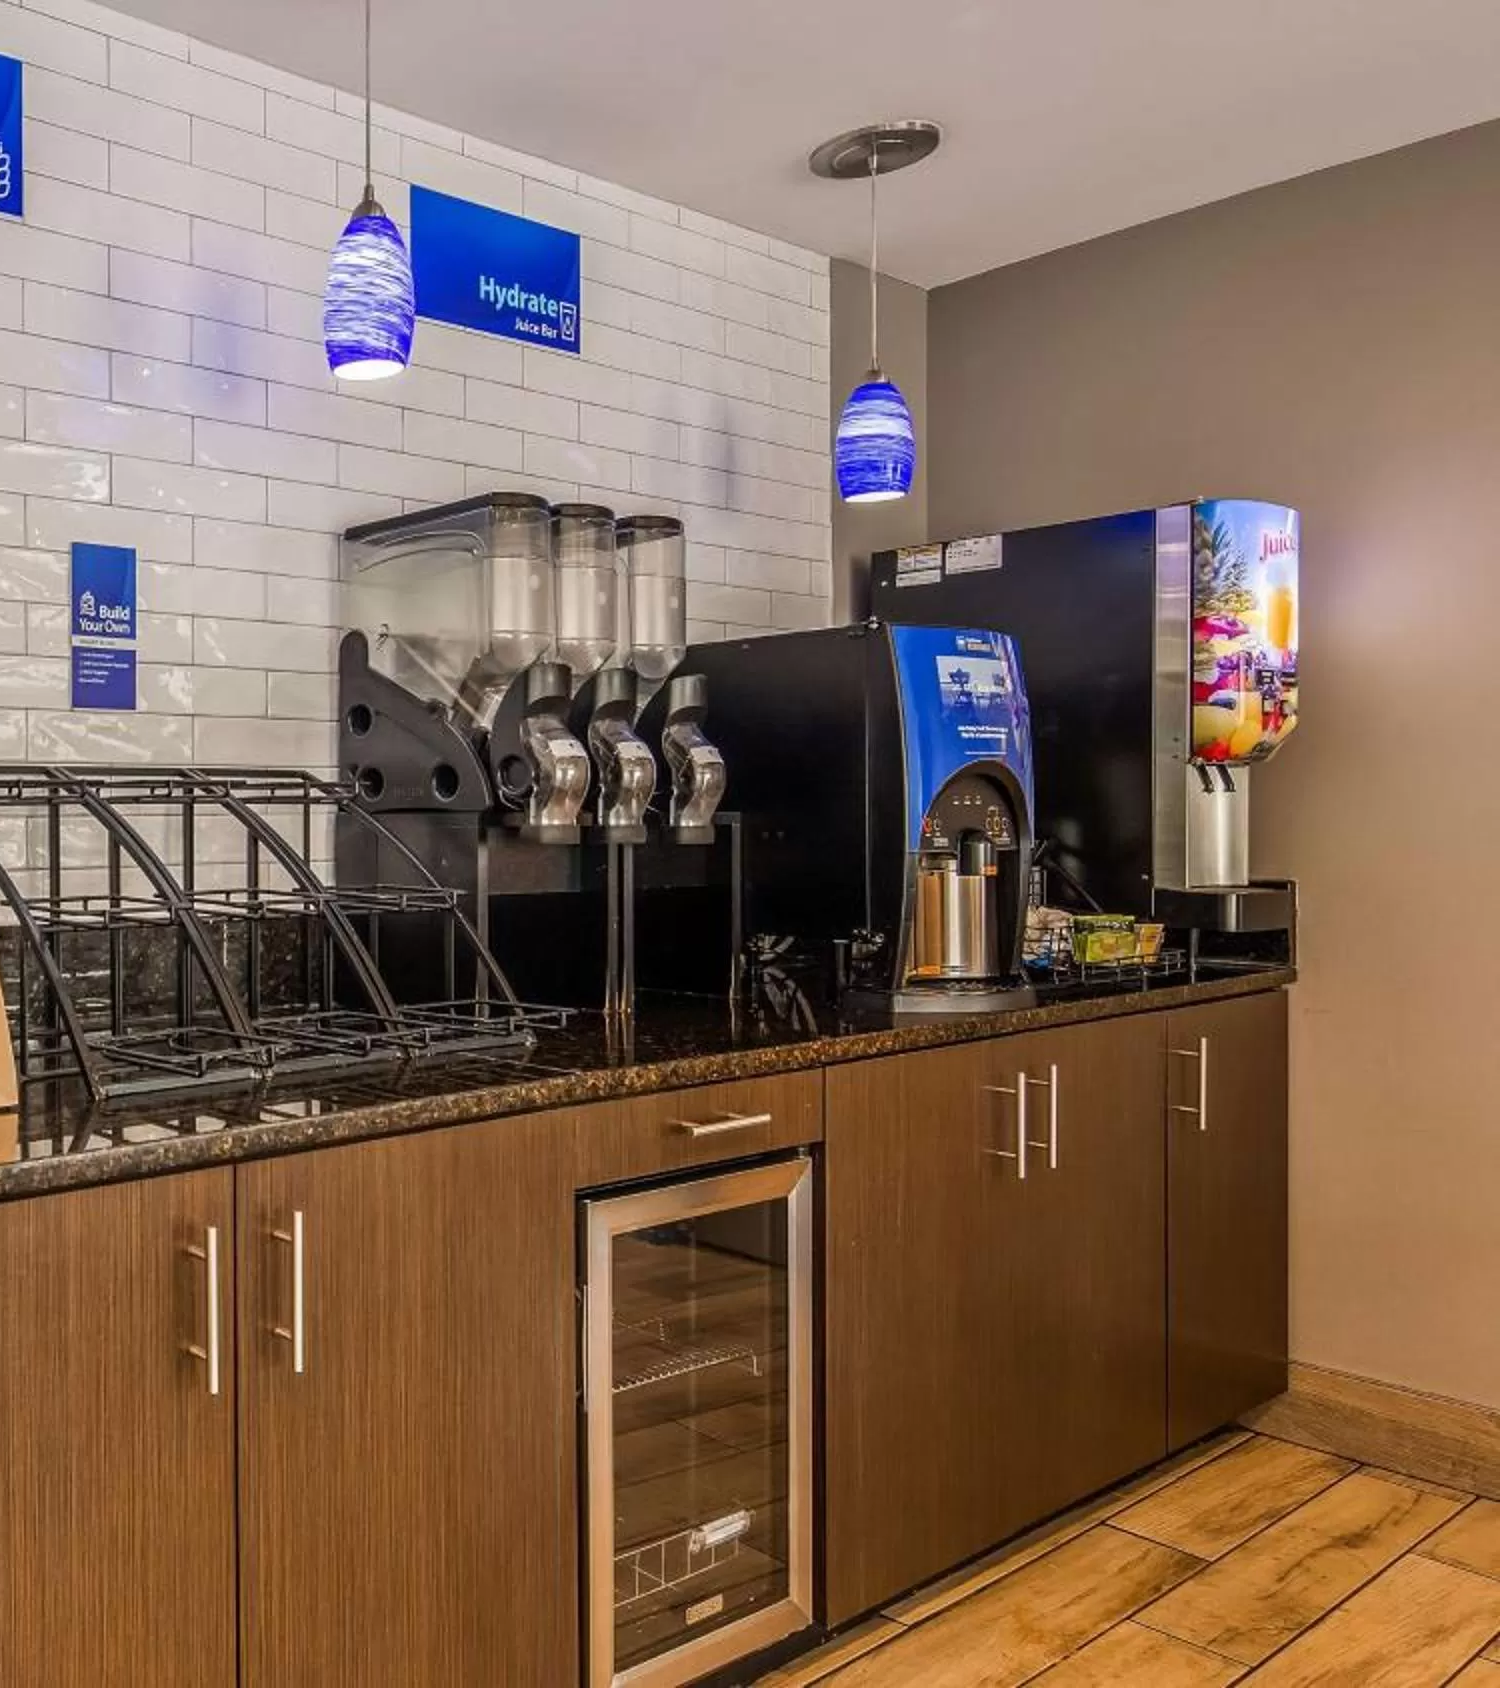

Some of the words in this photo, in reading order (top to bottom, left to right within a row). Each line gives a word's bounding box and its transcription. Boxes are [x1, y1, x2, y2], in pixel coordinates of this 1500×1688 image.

[479, 275, 559, 317] Hydrate
[515, 317, 539, 335] Juice
[541, 323, 558, 339] Bar
[99, 604, 130, 620] Build
[79, 618, 103, 631] Your
[105, 620, 130, 634] Own
